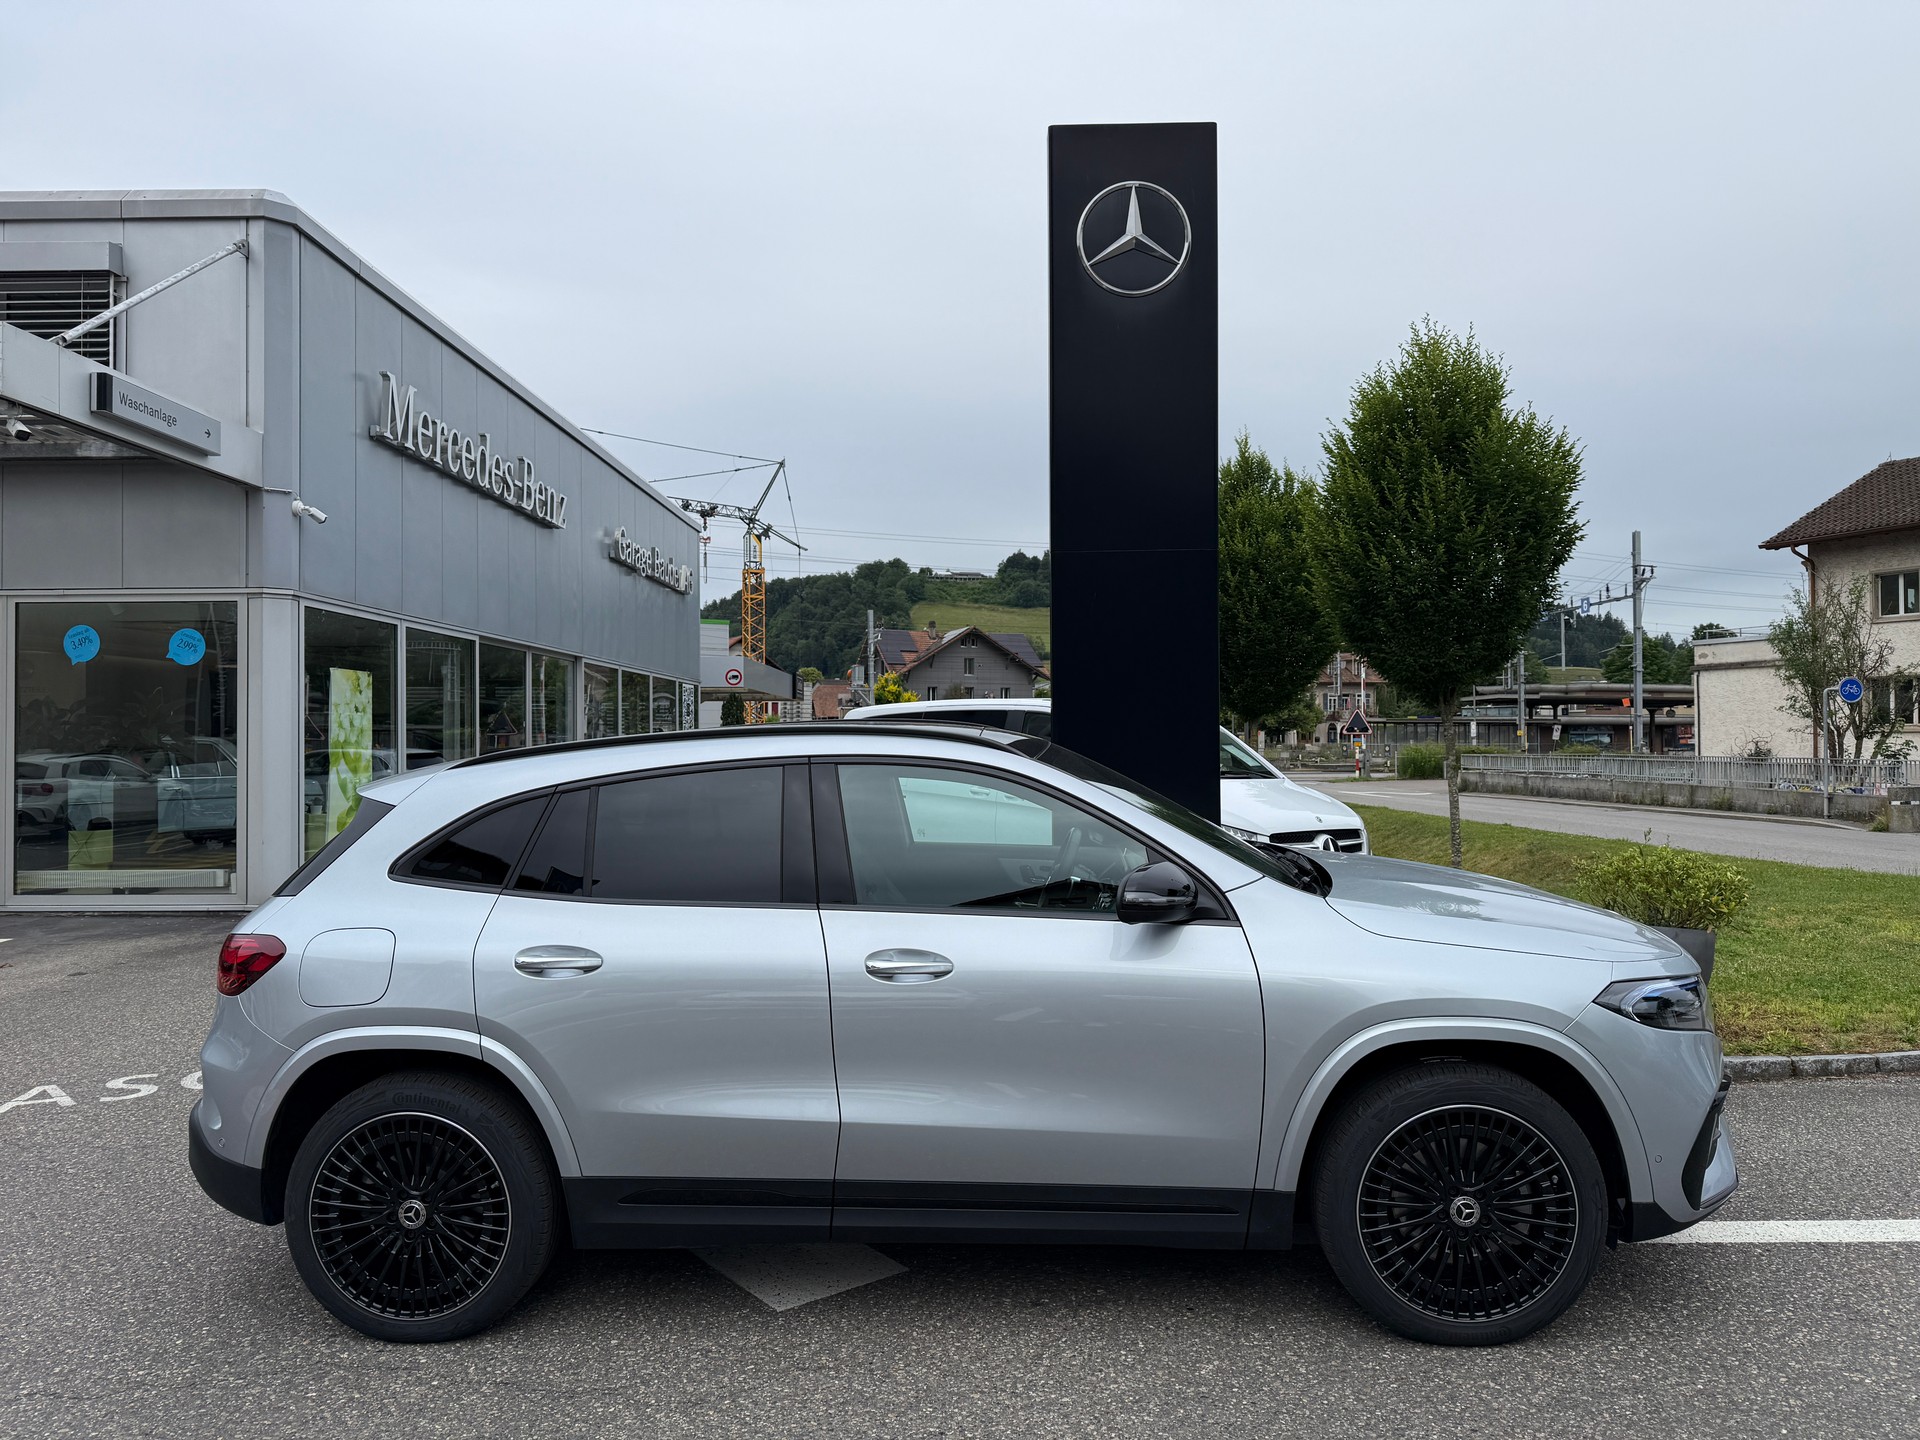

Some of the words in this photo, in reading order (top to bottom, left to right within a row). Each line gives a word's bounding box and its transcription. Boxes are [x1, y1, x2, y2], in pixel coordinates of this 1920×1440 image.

[118, 390, 178, 428] Waschanlage
[378, 370, 567, 529] Mercedes-Benz
[615, 525, 652, 577] Garage
[683, 564, 694, 595] AG
[1582, 600, 1588, 611] 6
[70, 634, 94, 650] 3.49%
[176, 638, 199, 654] 2.99%
[391, 1091, 463, 1115] Continental
